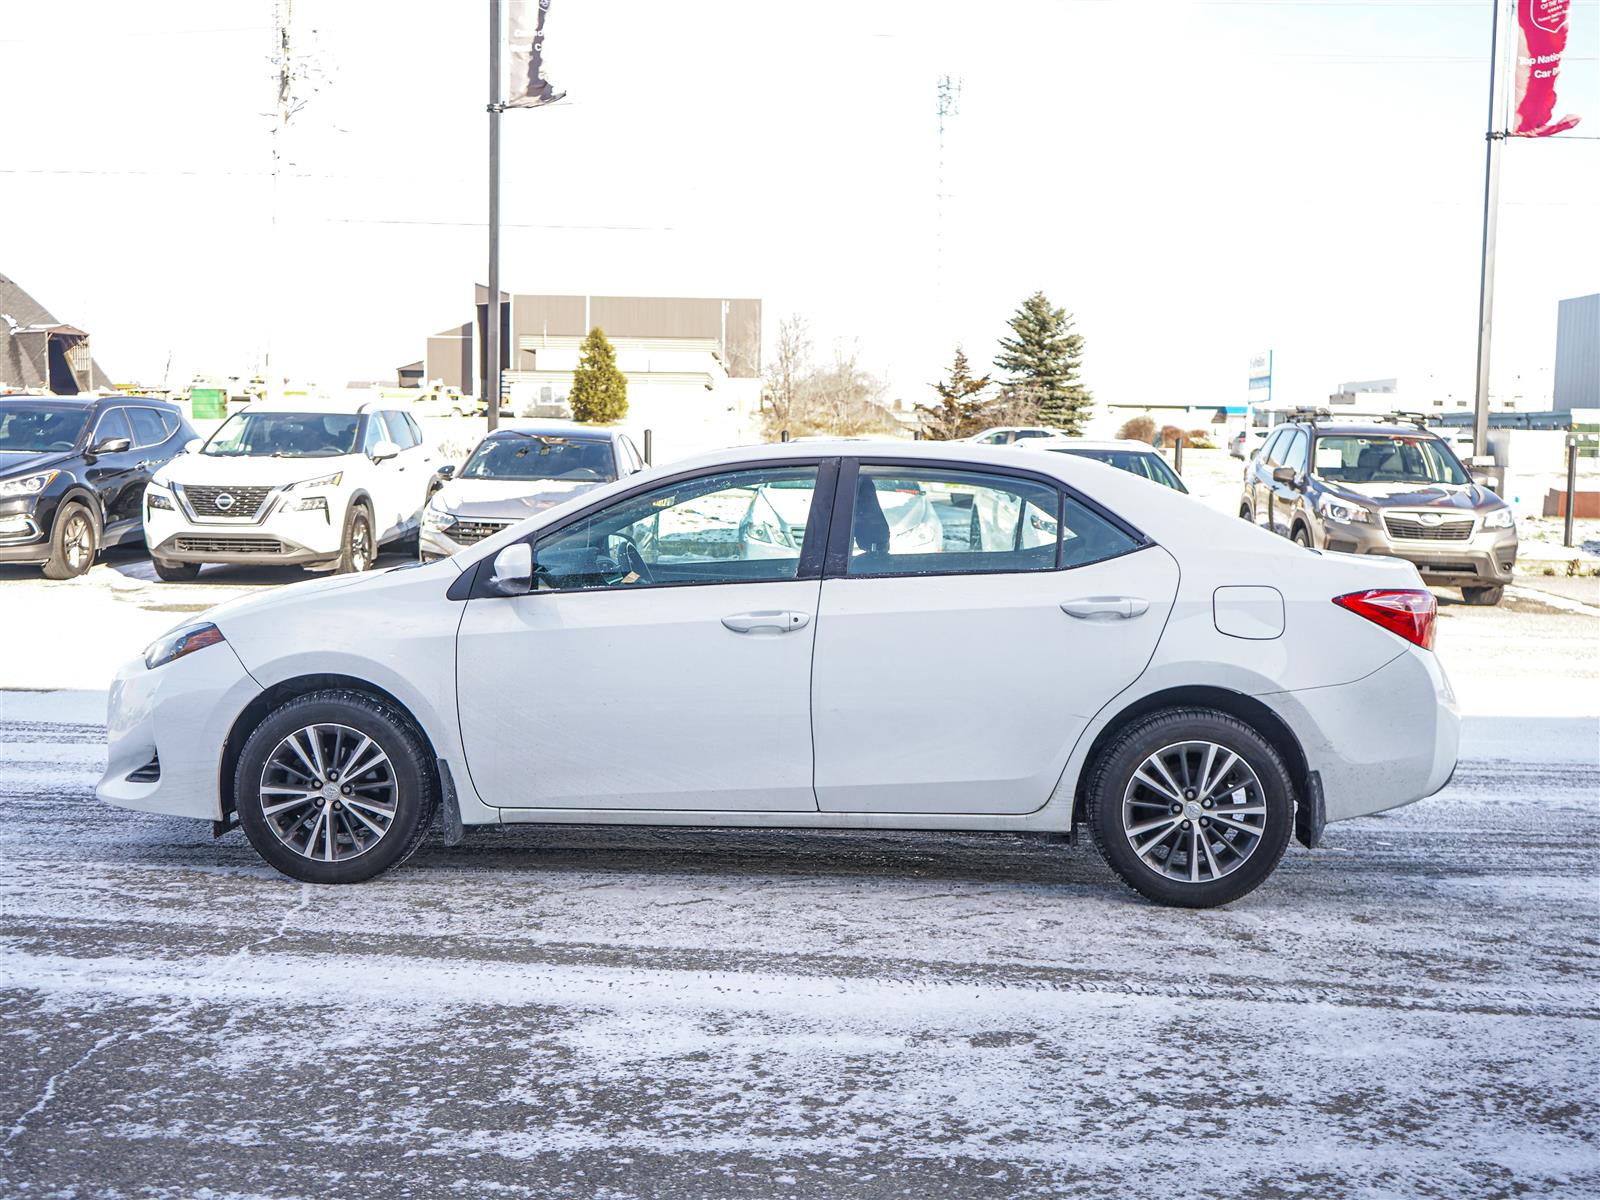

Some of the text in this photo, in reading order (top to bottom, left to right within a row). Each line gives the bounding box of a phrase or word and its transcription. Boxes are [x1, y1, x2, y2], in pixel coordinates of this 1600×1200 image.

[1518, 52, 1561, 67] Top Natio
[1534, 69, 1551, 78] Car
